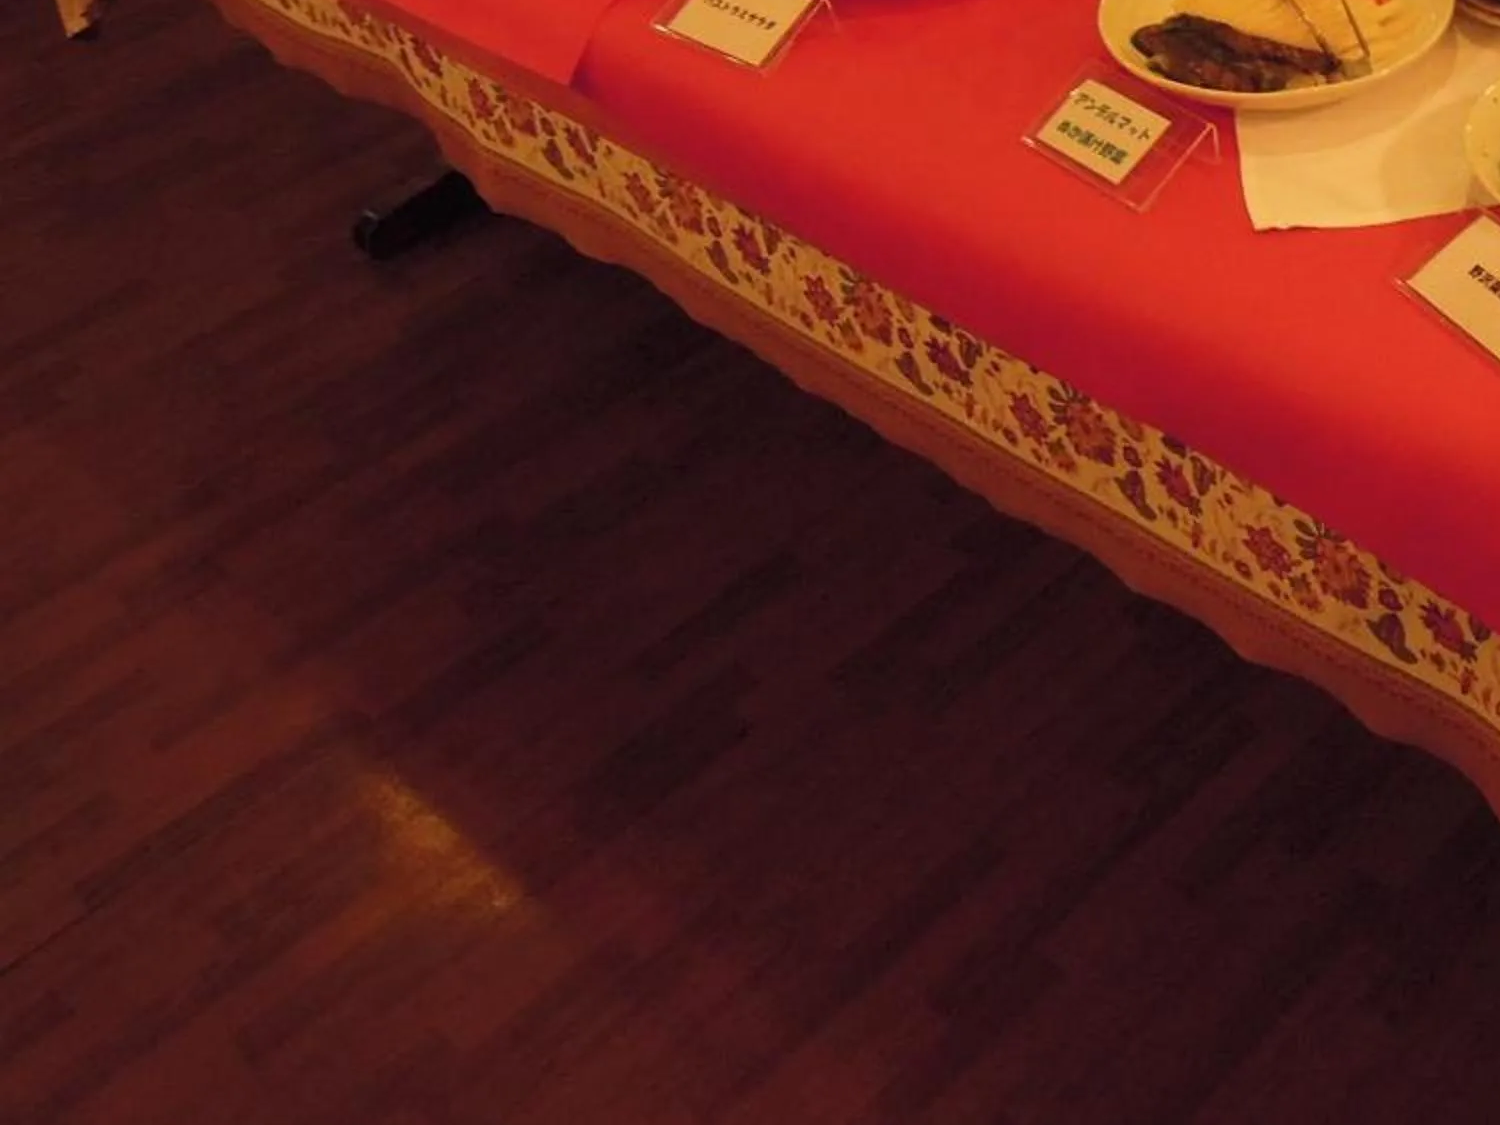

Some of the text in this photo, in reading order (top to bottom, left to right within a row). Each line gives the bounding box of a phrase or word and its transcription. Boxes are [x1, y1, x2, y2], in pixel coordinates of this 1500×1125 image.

[1074, 92, 1150, 141] アンデルマット
